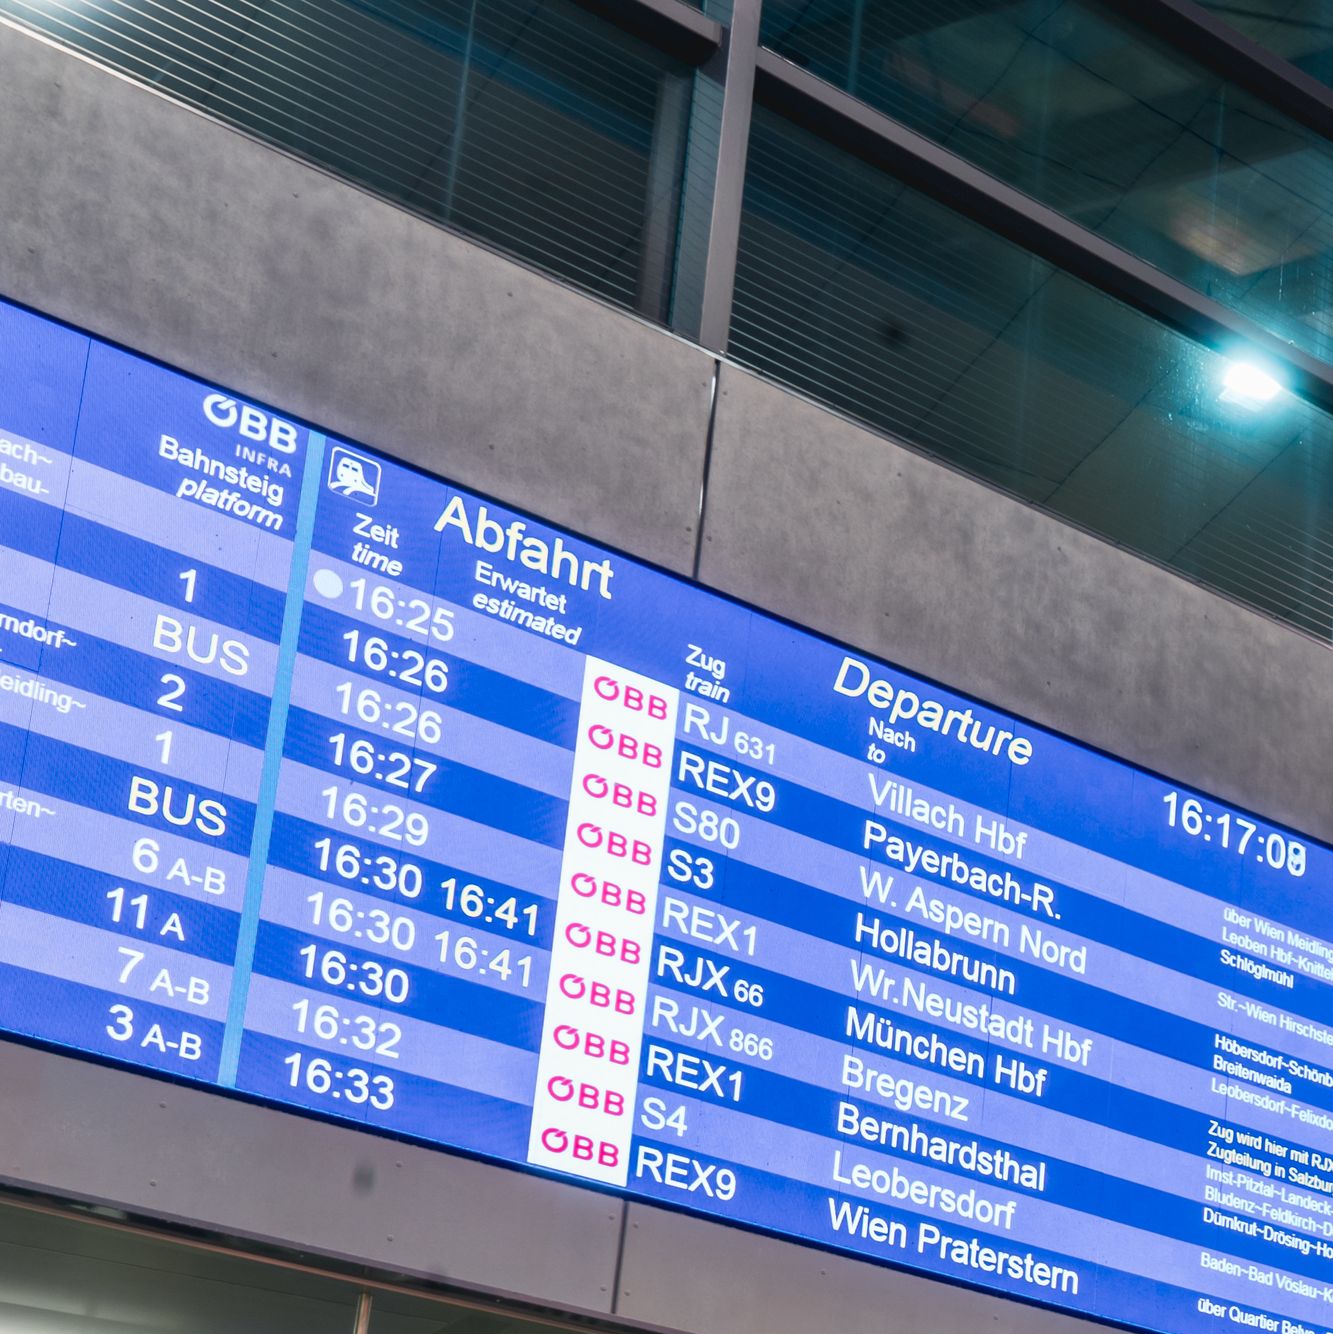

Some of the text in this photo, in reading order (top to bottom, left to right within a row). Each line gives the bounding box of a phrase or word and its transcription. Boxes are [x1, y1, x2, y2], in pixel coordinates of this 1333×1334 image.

[202, 393, 297, 454] ÖBB
[158, 434, 284, 507] Bahnsteig
[234, 444, 292, 477] INFRA
[175, 477, 283, 530] platform
[434, 495, 614, 600] Abfahrt
[350, 577, 455, 641] 16:25
[474, 559, 567, 614] Erwartet
[153, 614, 250, 676] BUS
[472, 592, 582, 645] estimated
[593, 675, 667, 721] ÖBB
[684, 671, 731, 703] train
[833, 656, 1033, 766] Departure
[683, 702, 775, 765] RJ 631
[868, 716, 916, 752] Nach
[678, 750, 776, 812] REX9
[868, 772, 1028, 859] Villach Hbf
[314, 837, 538, 936] 16:30 16:41
[863, 819, 1061, 920] Payerbach-R.
[106, 887, 186, 941] 11 A
[859, 865, 1087, 975] W. Aspern Nord
[656, 944, 764, 1007] RJX 66
[855, 912, 1015, 995] Hollabrunn
[1220, 948, 1294, 989] Schlöglmühl
[850, 958, 1093, 1066] Wr.Neustadt Hbf
[1216, 991, 1277, 1026] Str.~Wien
[284, 1052, 394, 1110] 16:33
[845, 1005, 1048, 1097] München Hbf
[1212, 1053, 1292, 1094] Breitenwaida
[841, 1054, 969, 1122] Bregenz
[836, 1101, 1046, 1191] Bernhardsthal
[1206, 1140, 1272, 1177] Zugteilung
[1273, 1165, 1286, 1179] in
[1207, 1119, 1234, 1144] Zug
[1235, 1131, 1263, 1150] wird
[1264, 1138, 1288, 1158] hier
[1289, 1149, 1310, 1165] mit
[832, 1150, 1017, 1230] Leobersdorf
[828, 1197, 1079, 1295] Wien Praterstern
